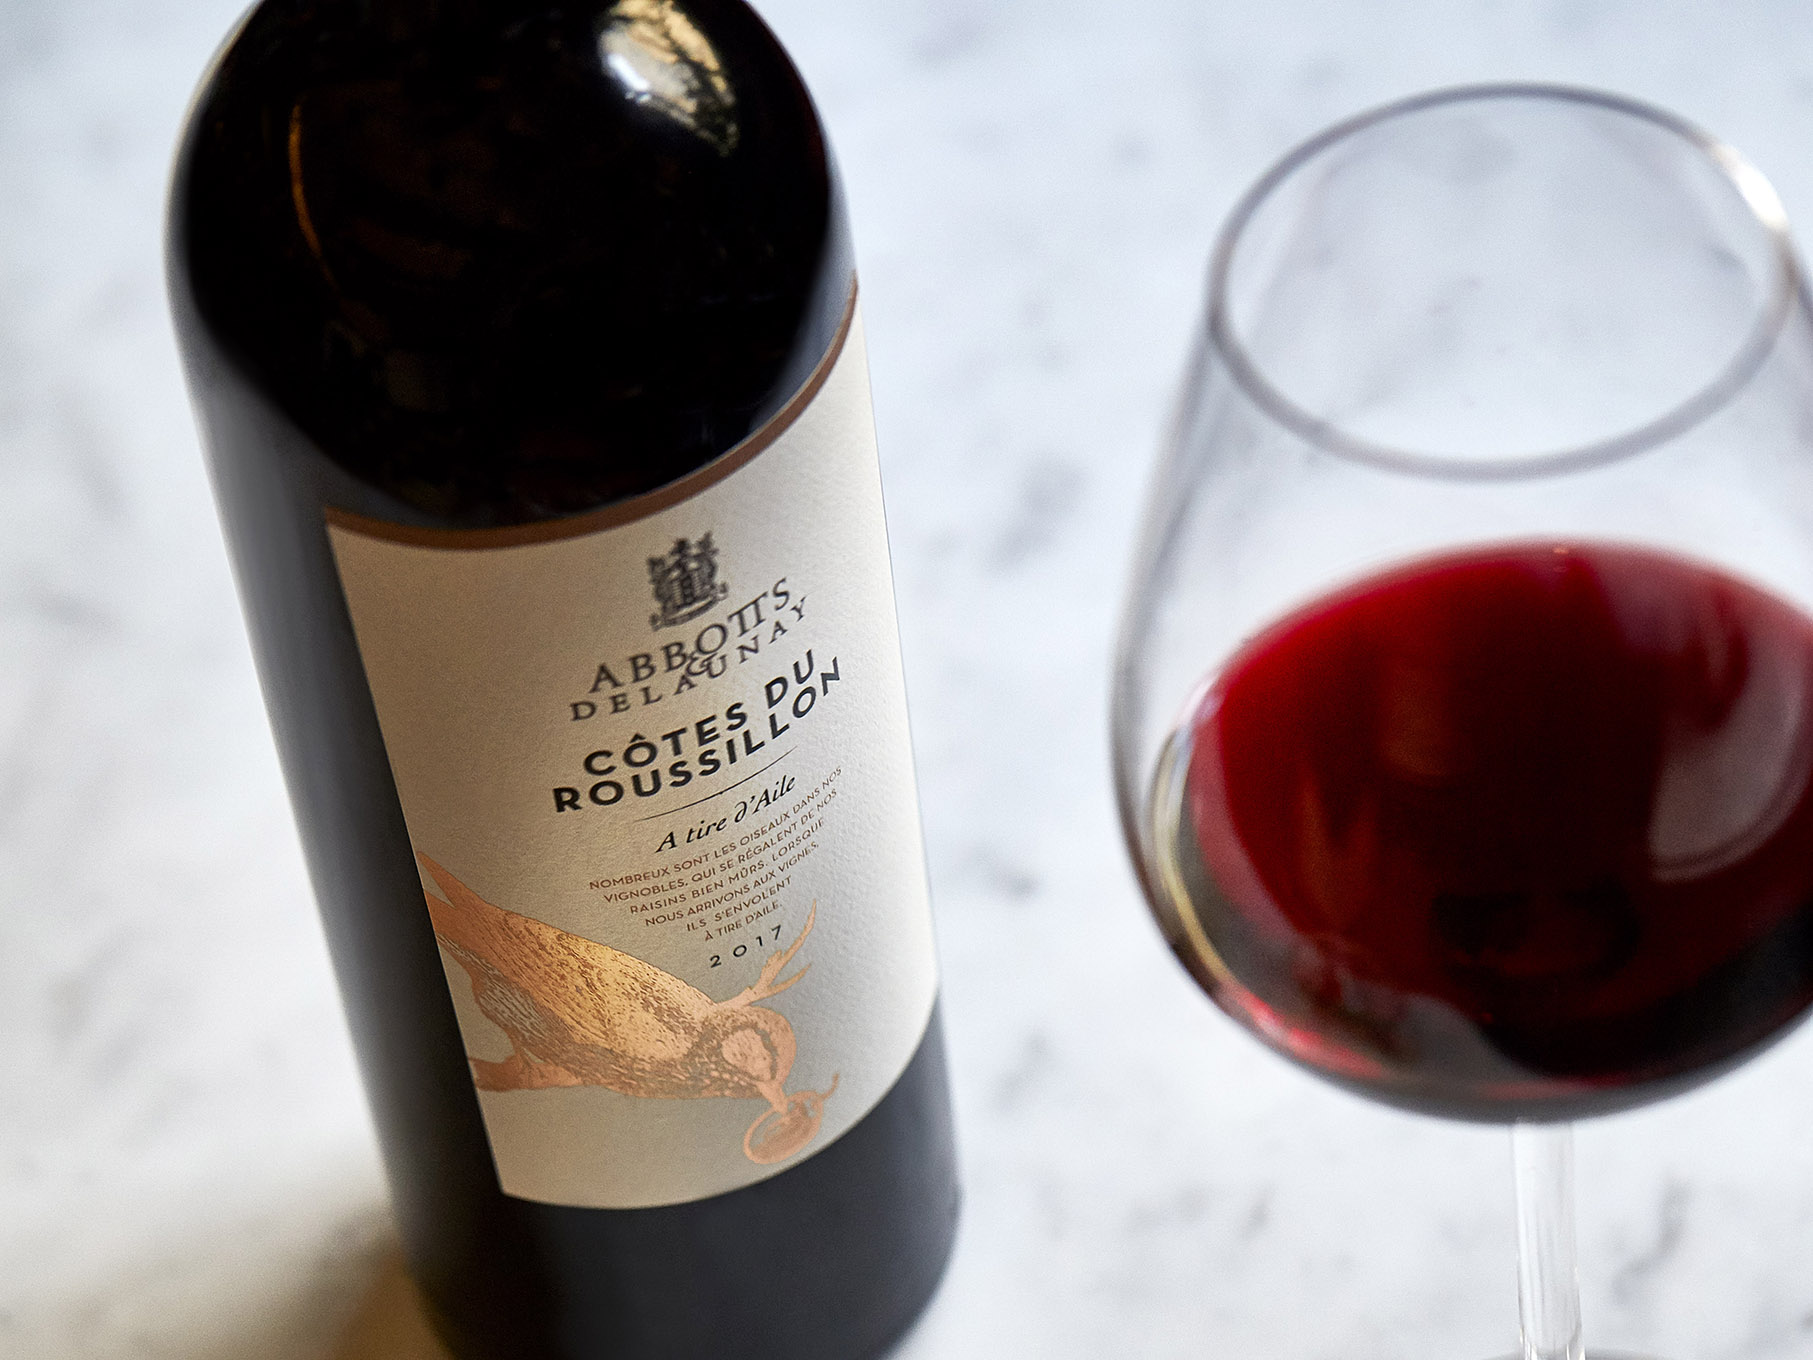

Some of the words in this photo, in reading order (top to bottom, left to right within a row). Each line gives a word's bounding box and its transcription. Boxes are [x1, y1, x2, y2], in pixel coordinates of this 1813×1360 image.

[569, 596, 809, 721] DELAUNAY
[588, 578, 790, 694] ABBOTTS
[552, 656, 840, 813] ROUSSILLON
[583, 702, 747, 776] CÔTES
[764, 649, 814, 709] DU
[589, 867, 671, 890] NOMBREUX
[674, 853, 710, 872] SONT
[714, 842, 736, 858] LES
[740, 812, 790, 846] OISEAUX
[793, 787, 820, 814] DANS
[822, 766, 842, 789] NOS
[654, 831, 678, 853] A
[686, 818, 727, 843] tire
[734, 775, 795, 823] d'Aile
[692, 868, 716, 882] QUI
[720, 860, 735, 872] SE
[738, 822, 798, 863] RÉGALENT
[801, 809, 815, 825] DE
[816, 789, 837, 811] NOS
[630, 893, 686, 914] RAISINS
[692, 880, 724, 898] BIEN
[772, 818, 824, 861] LORSQUE
[646, 910, 684, 926] NOUS
[687, 884, 750, 916] ARRIVONS
[753, 871, 777, 889] AUX
[687, 919, 706, 931] ILS
[714, 875, 792, 921] S'ENVOLENT
[710, 924, 781, 968] 2017
[717, 921, 742, 936] TIRE
